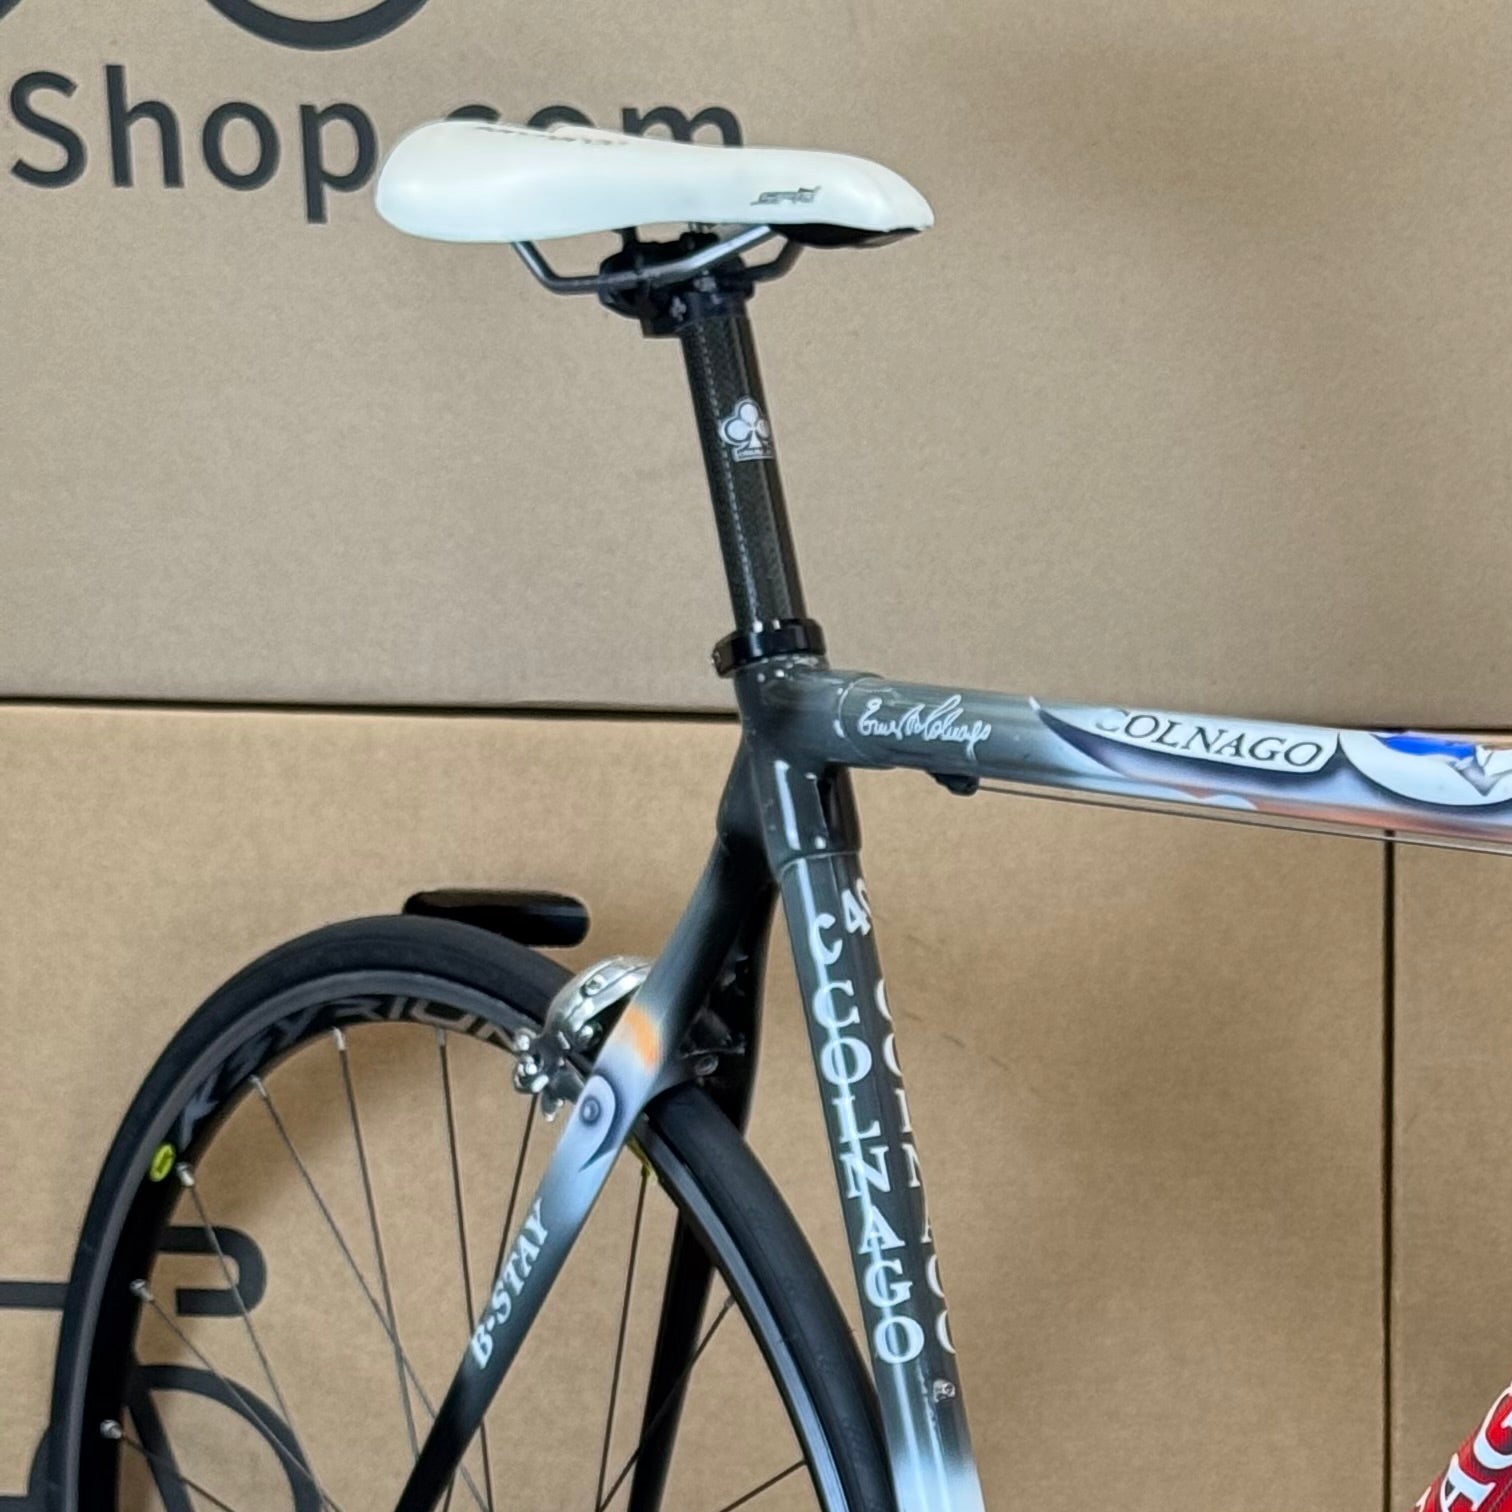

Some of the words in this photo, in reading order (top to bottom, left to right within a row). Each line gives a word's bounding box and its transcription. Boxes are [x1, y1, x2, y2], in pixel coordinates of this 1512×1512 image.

[1095, 706, 1324, 767] COLNAGO
[812, 978, 925, 1366] COLNAGO
[470, 1198, 550, 1371] B-STAY
